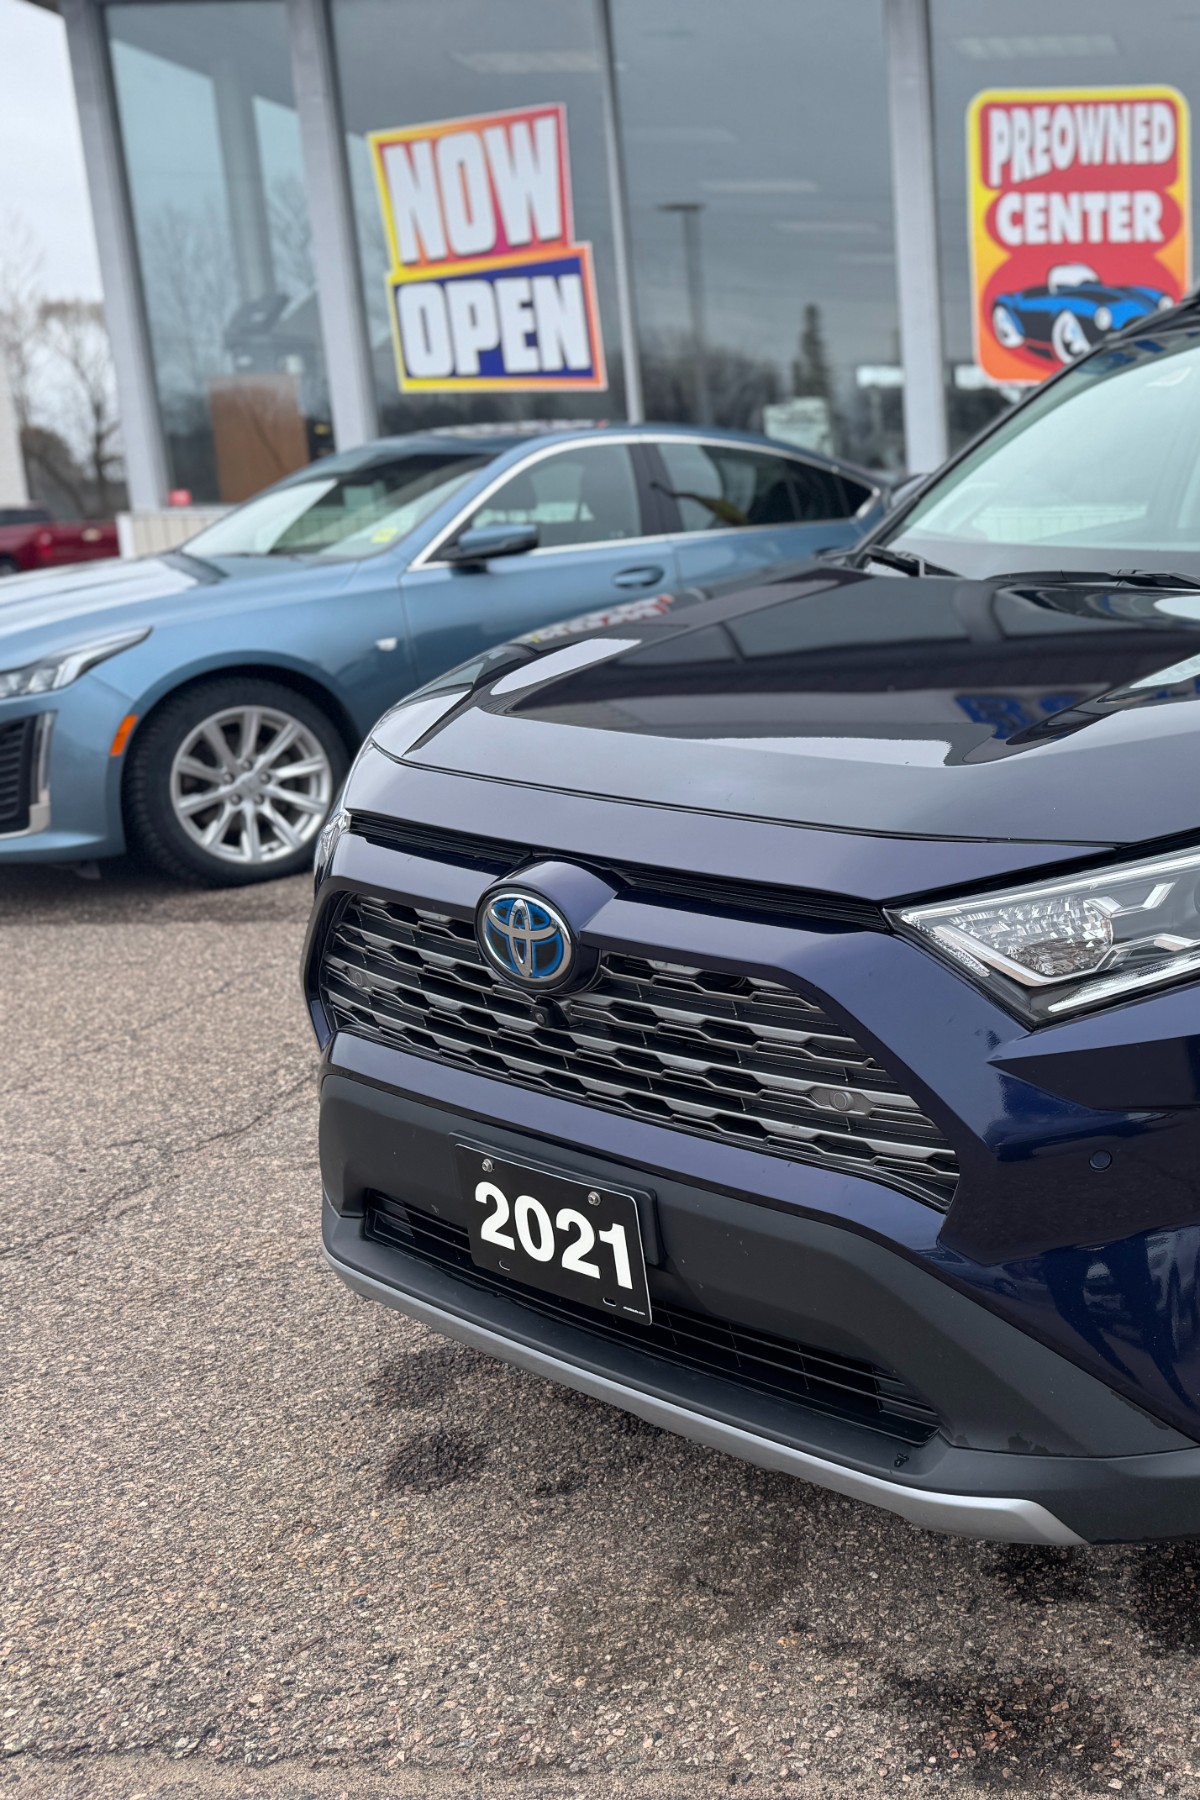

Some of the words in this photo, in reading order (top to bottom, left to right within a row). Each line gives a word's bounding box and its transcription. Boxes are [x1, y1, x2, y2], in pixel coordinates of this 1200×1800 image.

[381, 115, 563, 265] NOW
[987, 102, 1176, 188] PREOWNED
[995, 190, 1166, 246] CENTER
[396, 272, 592, 378] OPEN
[474, 1181, 633, 1290] 2021
